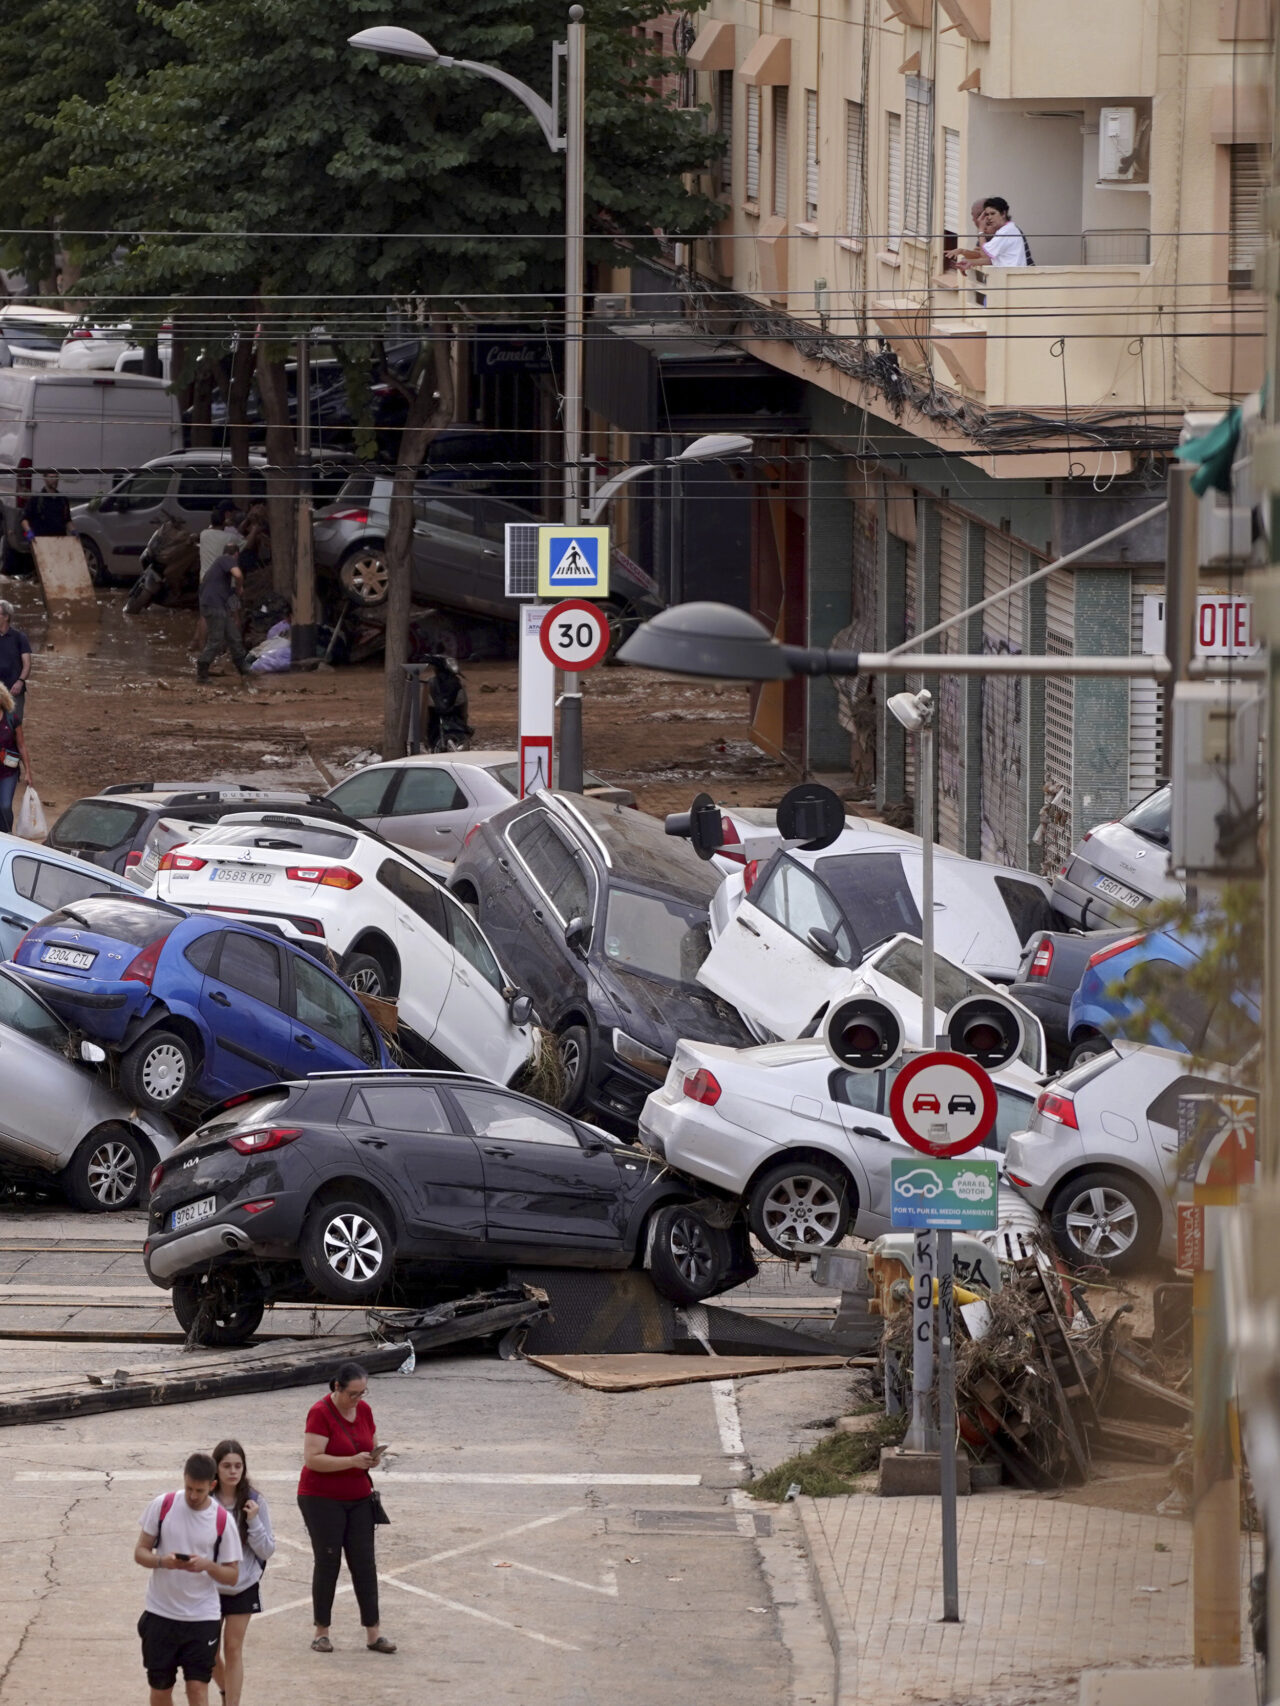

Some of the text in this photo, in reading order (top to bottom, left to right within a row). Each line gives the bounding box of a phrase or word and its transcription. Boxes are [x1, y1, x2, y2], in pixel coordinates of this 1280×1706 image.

[558, 623, 593, 648] 30
[218, 869, 271, 884] 0588 KPD
[1099, 879, 1140, 907] 5601 JYR
[48, 949, 89, 966] 2304 CTL
[176, 1206, 195, 1224] 9762
